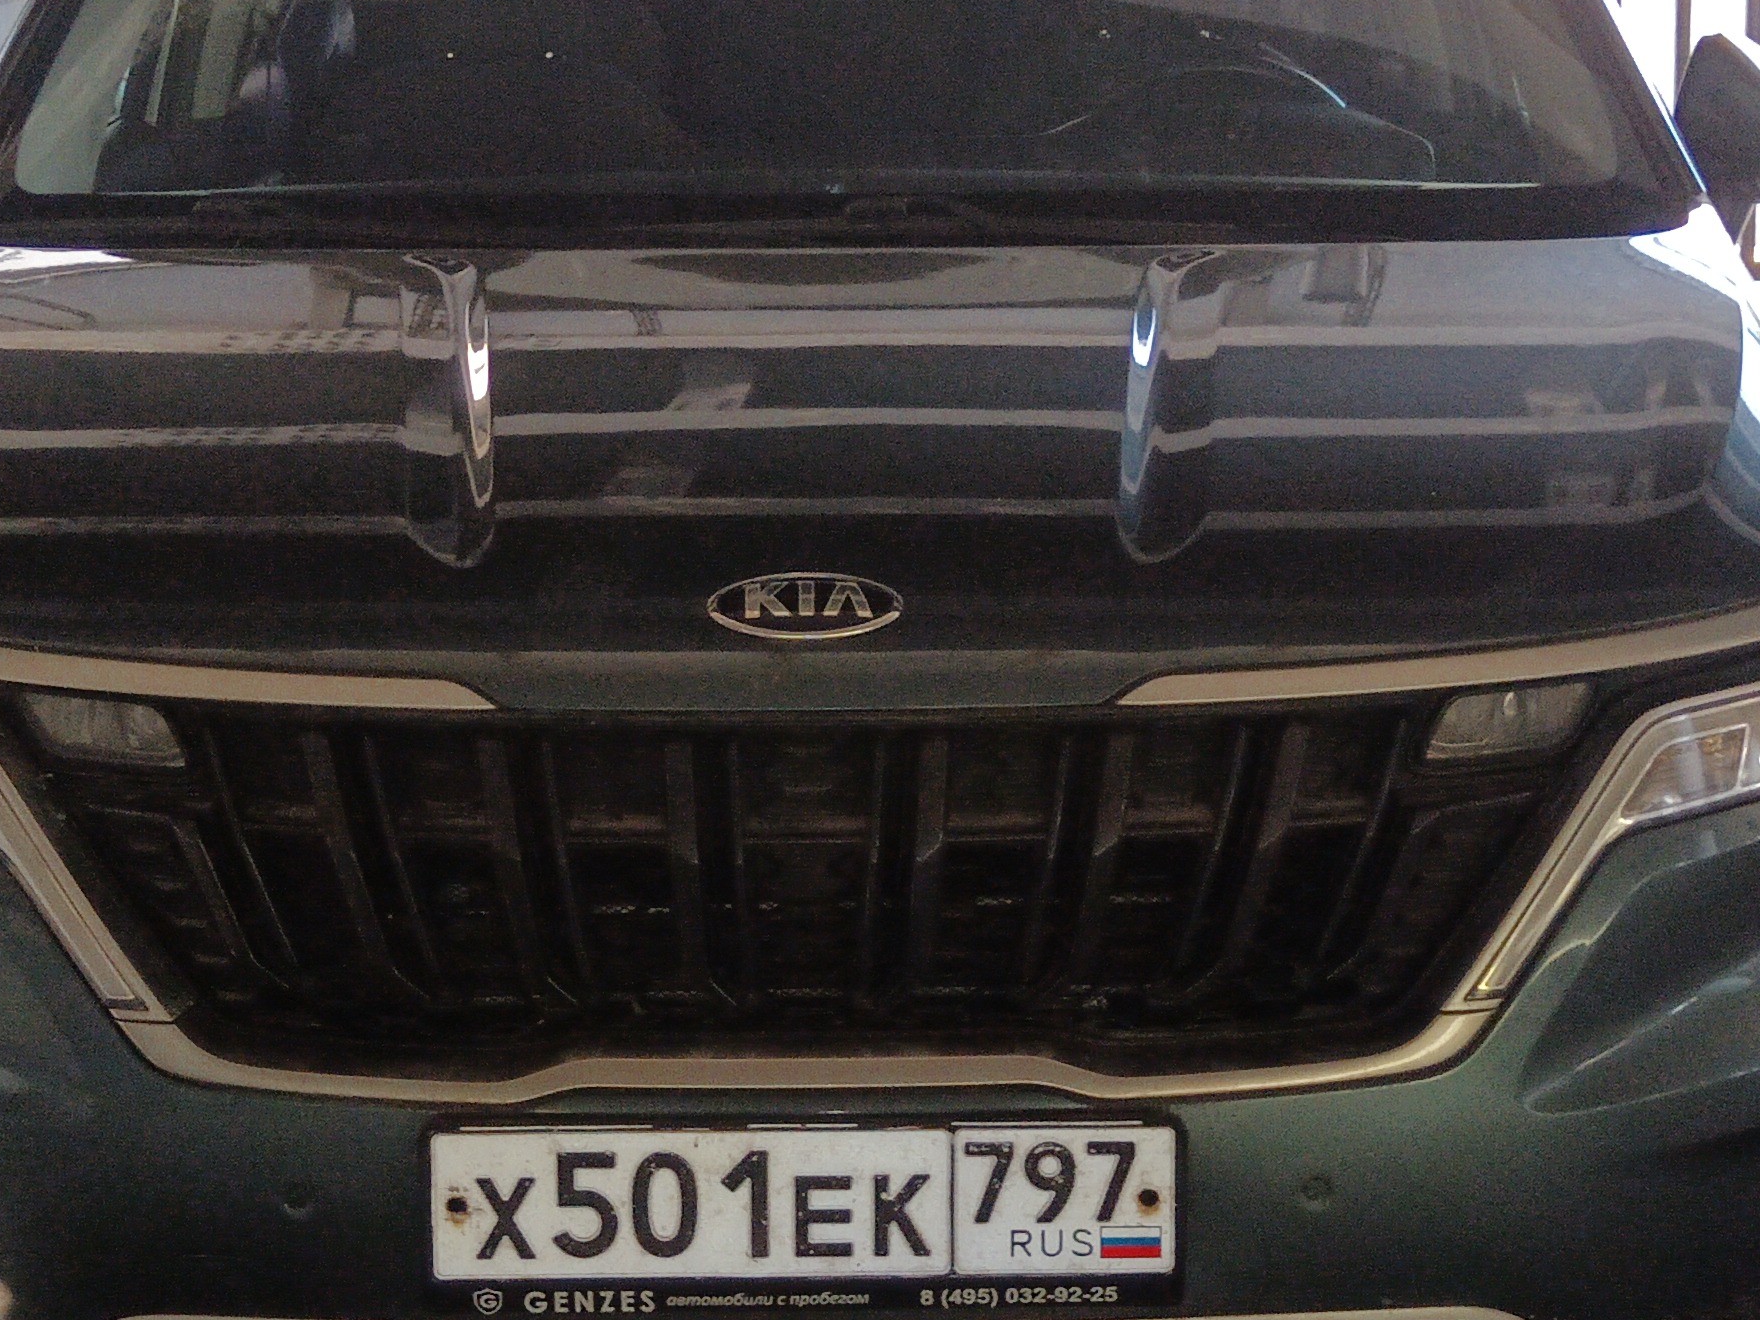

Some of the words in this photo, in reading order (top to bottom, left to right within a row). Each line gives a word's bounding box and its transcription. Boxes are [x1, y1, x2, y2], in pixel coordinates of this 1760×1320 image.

[743, 580, 874, 619] KIA
[963, 1141, 1138, 1224] 797
[1009, 1229, 1094, 1258] RUS
[523, 1290, 656, 1314] GENZES
[666, 1292, 773, 1307] автомобили
[777, 1294, 787, 1306] с
[789, 1291, 870, 1308] пробегом
[919, 1289, 935, 1306] 8
[941, 1287, 999, 1309] (495)
[1005, 1286, 1119, 1304] 032-92-25
